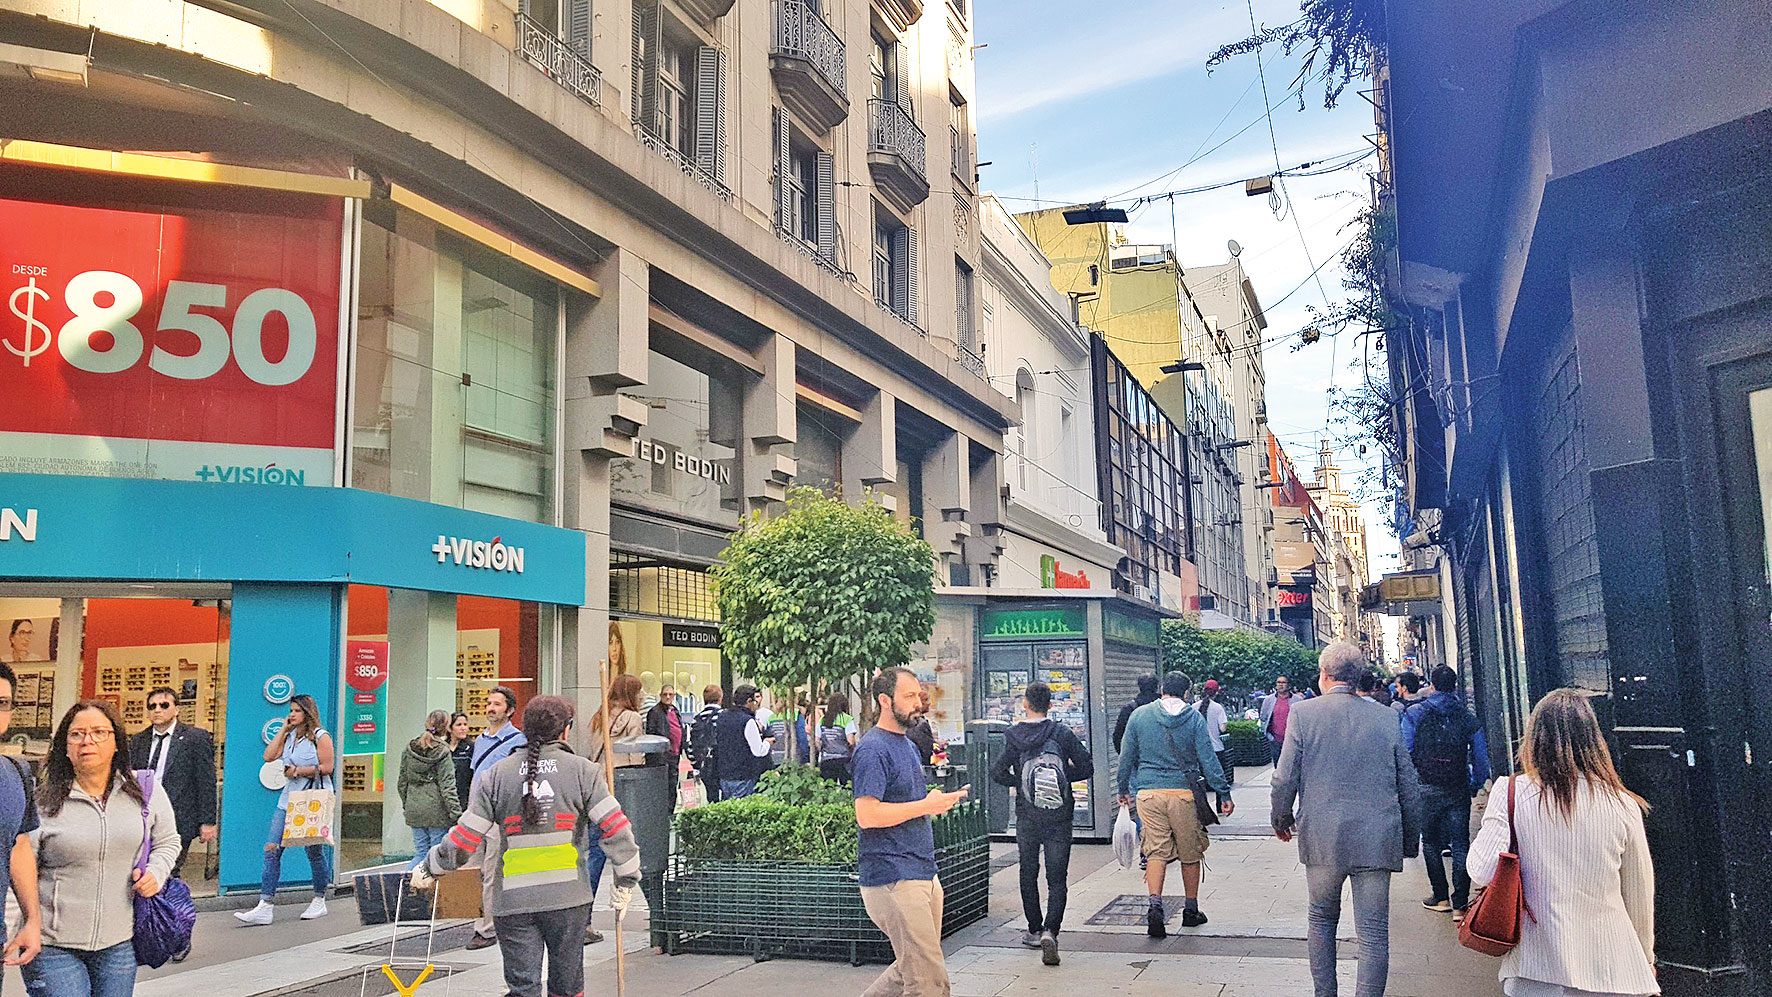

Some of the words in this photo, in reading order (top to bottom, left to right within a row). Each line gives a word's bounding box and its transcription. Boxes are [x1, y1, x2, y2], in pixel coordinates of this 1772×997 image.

[12, 264, 48, 277] DESDE
[2, 270, 317, 386] $850
[630, 436, 667, 465] TED
[674, 450, 731, 485] BODIN
[431, 535, 525, 573] +VISIÓN
[671, 630, 688, 641] TED
[690, 631, 717, 643] BODIN
[354, 665, 379, 677] $850
[521, 759, 557, 769] HIENE
